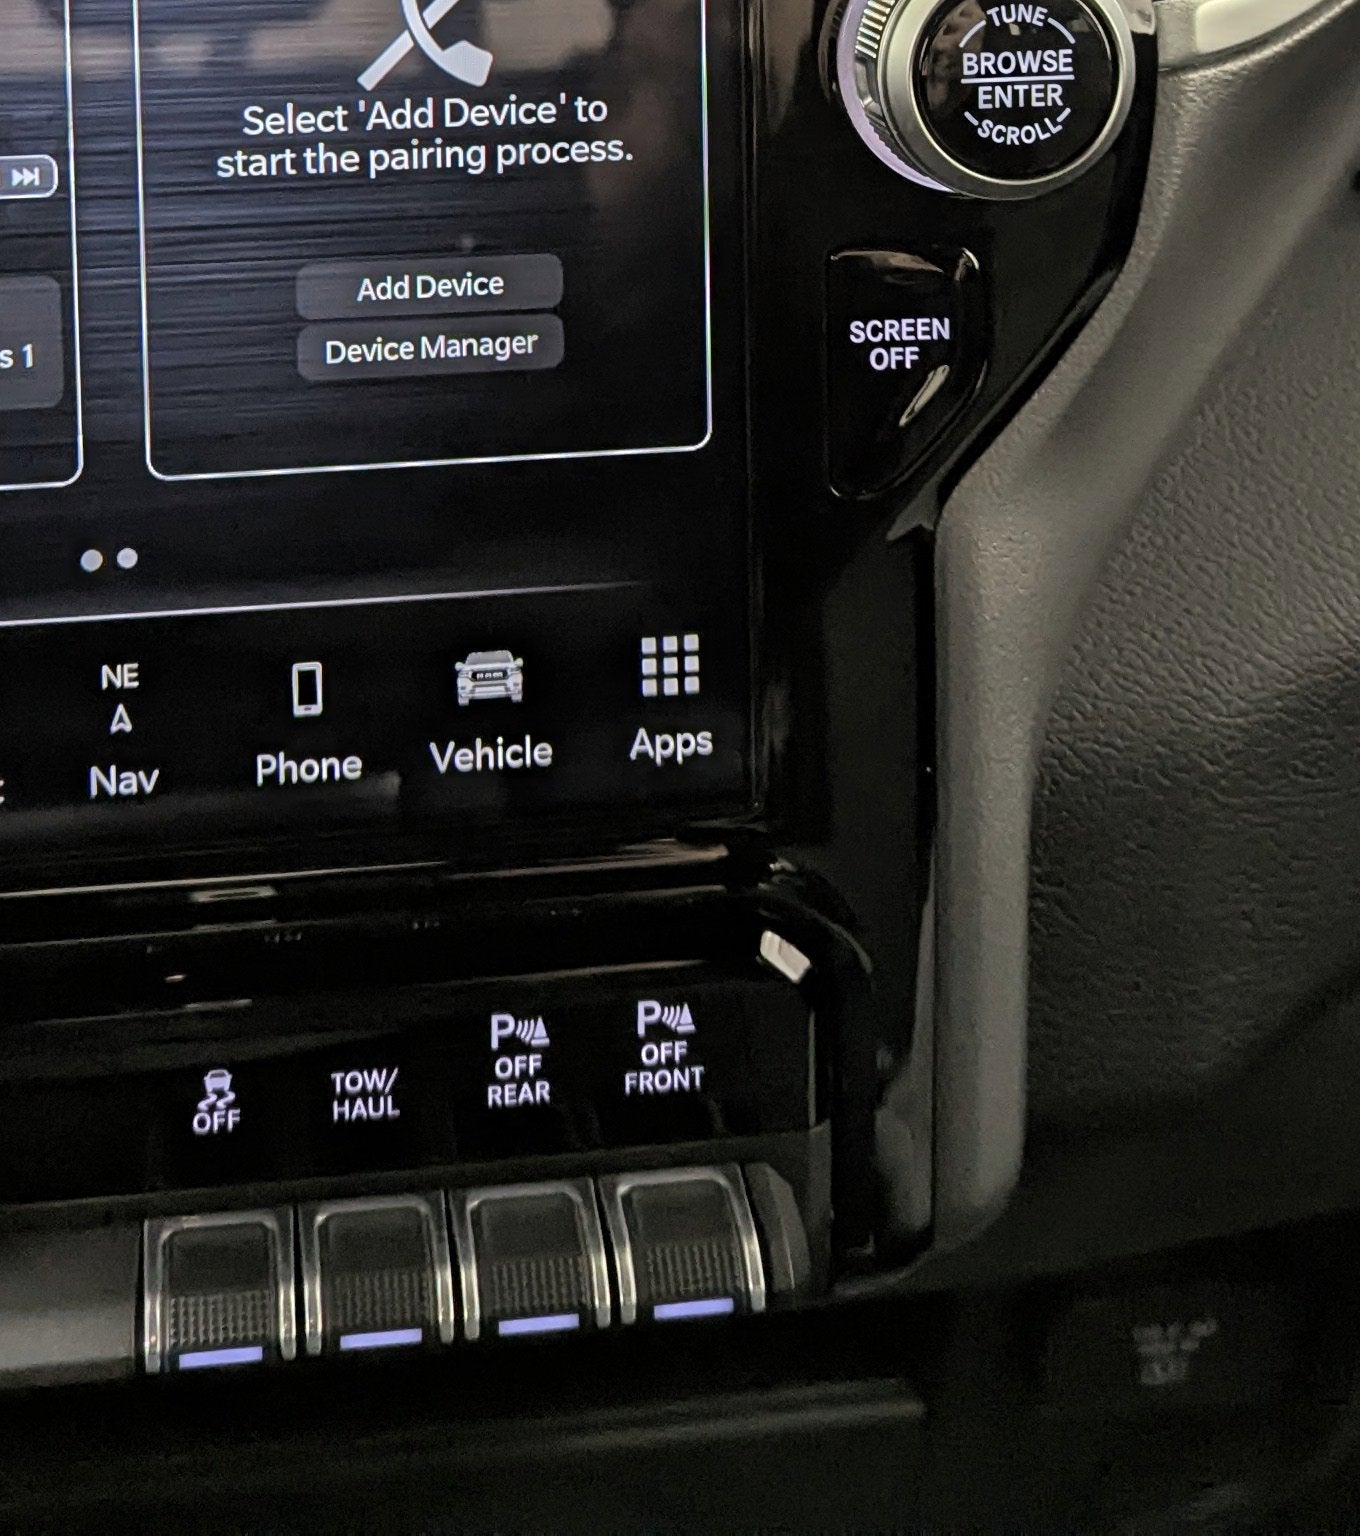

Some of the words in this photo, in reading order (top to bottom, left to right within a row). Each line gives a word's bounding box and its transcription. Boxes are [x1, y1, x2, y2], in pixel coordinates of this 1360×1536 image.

[986, 3, 1048, 27] TUNE
[962, 48, 1074, 76] BROWSE
[978, 83, 1064, 110] ENTER
[242, 102, 349, 136] Select
[358, 96, 434, 131] 'Add
[444, 92, 566, 128] Device'
[573, 96, 608, 123] to
[977, 117, 1063, 146] SCROLL
[216, 148, 297, 178] start
[302, 142, 360, 174] the
[369, 137, 486, 179] pairing
[497, 139, 633, 174] process.
[356, 274, 410, 302] Add
[416, 271, 504, 299] Device
[849, 317, 950, 344] SCREEN
[22, 343, 33, 368] 1
[325, 336, 415, 365] Device
[420, 334, 539, 362] Manager
[869, 346, 920, 371] OFF
[101, 662, 140, 690] NE
[429, 734, 553, 773] Vehicle
[629, 727, 713, 766] Apps
[89, 764, 160, 798] Nav
[256, 751, 363, 786] Phone
[490, 1013, 516, 1050] P
[637, 1000, 662, 1037] P
[494, 1054, 542, 1079] OFF
[640, 1040, 688, 1066] OFF
[331, 1067, 398, 1094] TOW/
[487, 1080, 550, 1107] REAR
[624, 1066, 704, 1094] FRONT
[192, 1109, 241, 1133] OFF
[332, 1095, 400, 1121] HAUL
